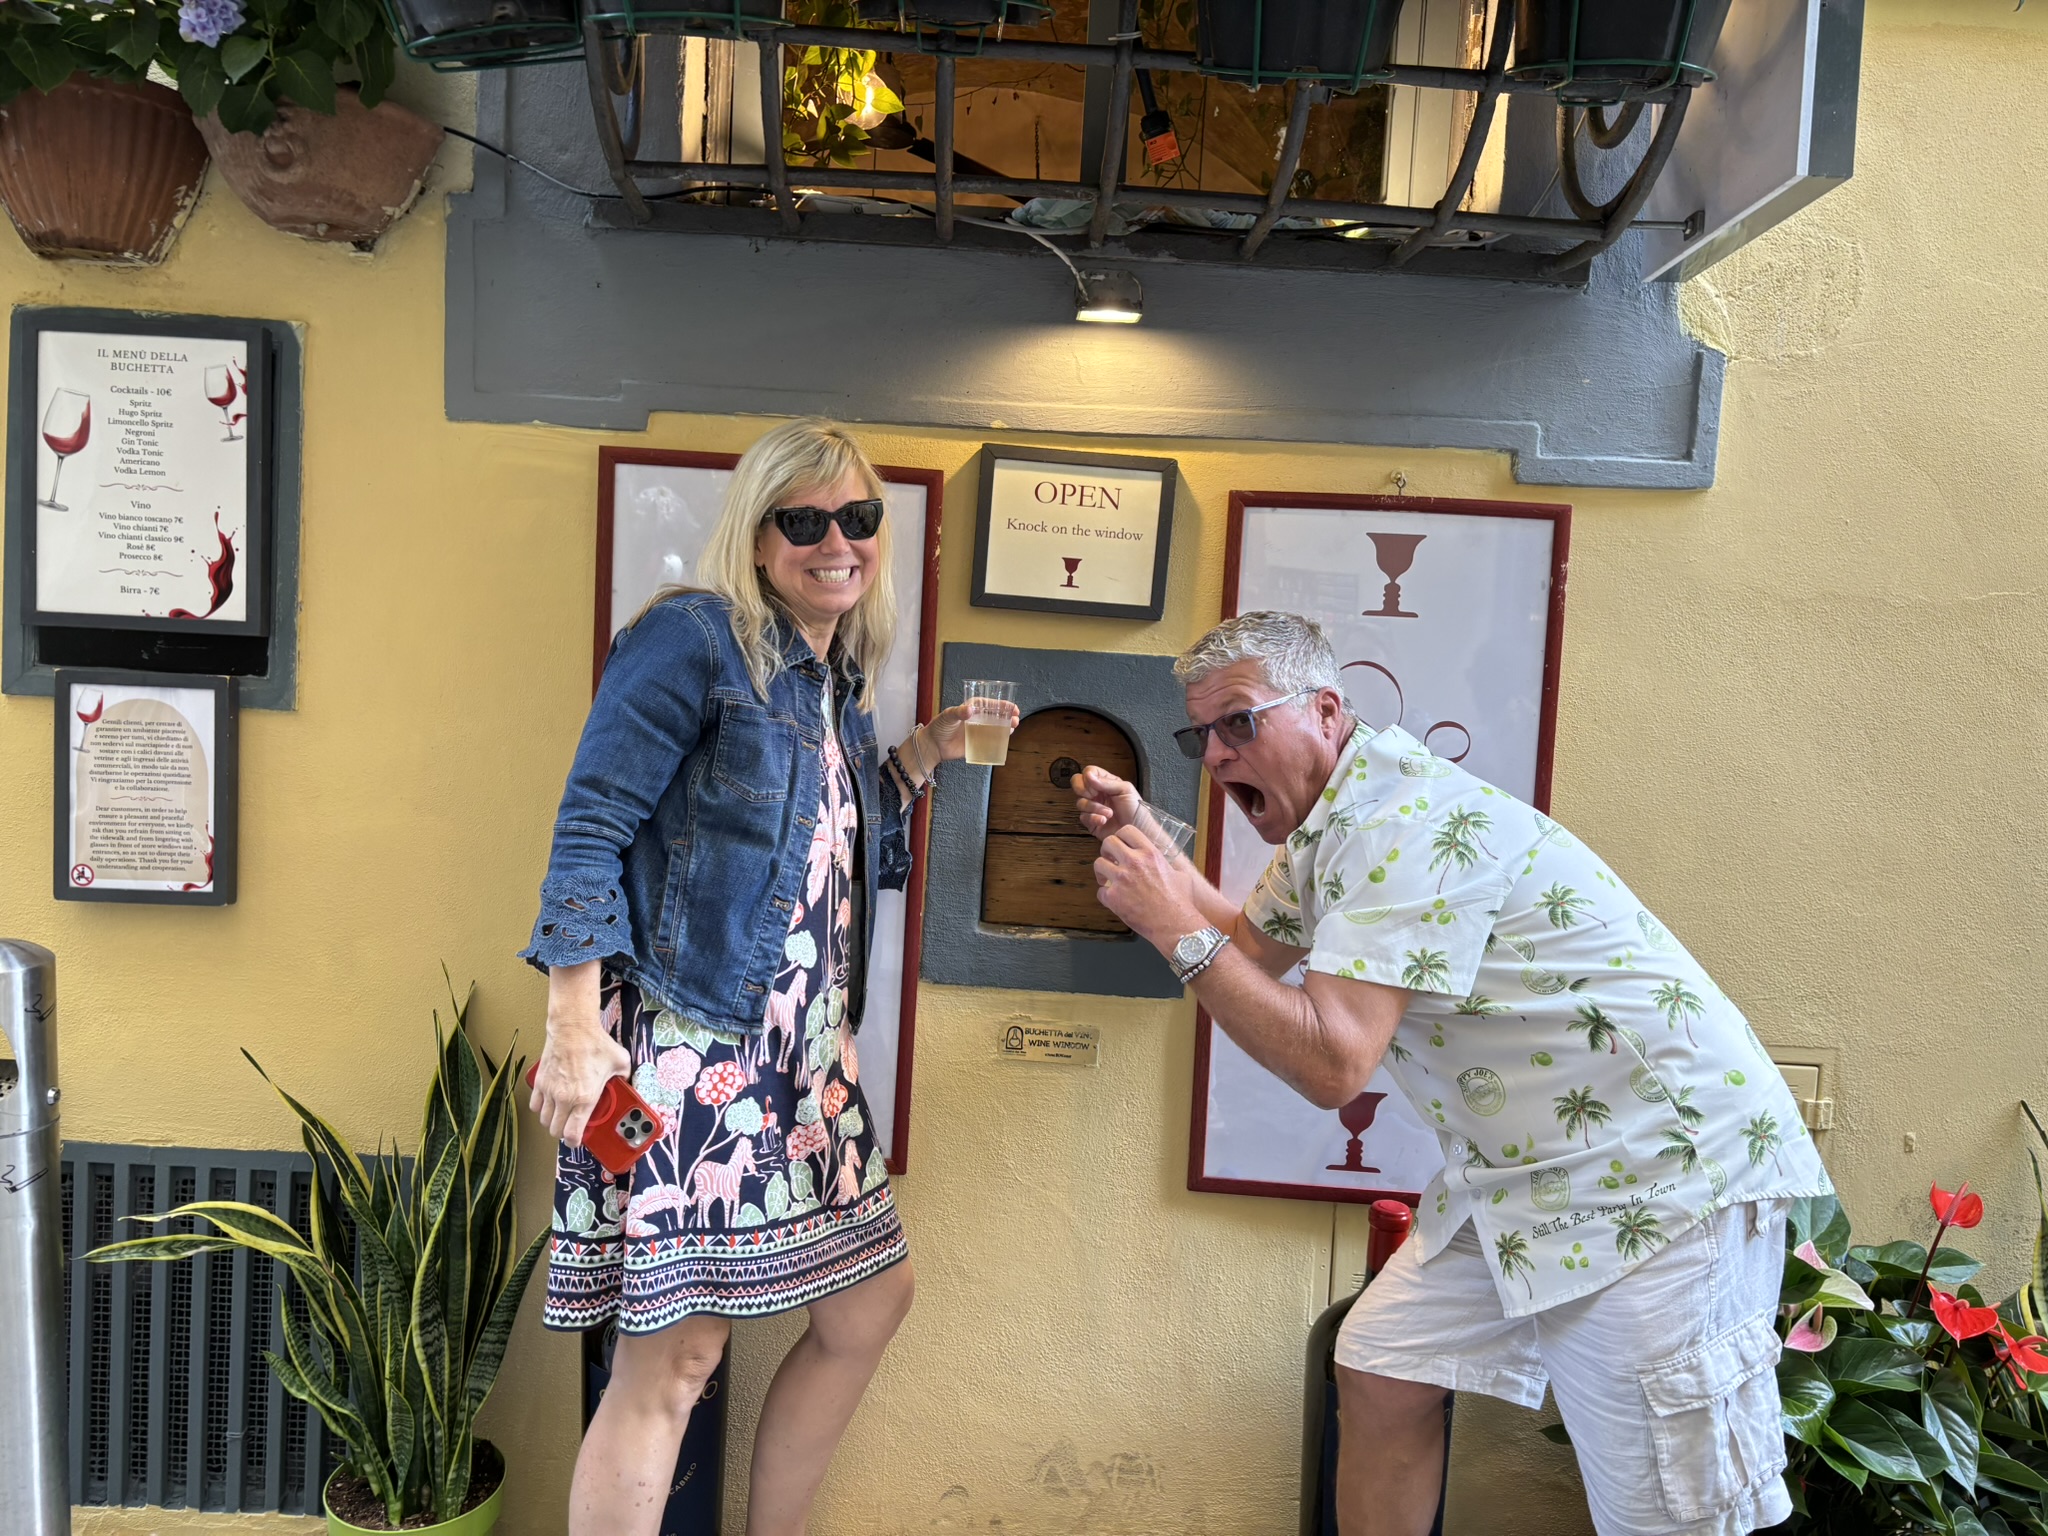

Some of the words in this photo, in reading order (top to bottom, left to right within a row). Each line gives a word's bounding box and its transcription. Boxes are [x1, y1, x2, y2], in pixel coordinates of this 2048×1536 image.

[98, 349, 108, 358] IL
[112, 350, 146, 360] MENÙ
[150, 352, 188, 362] DELLA
[110, 362, 174, 374] BUCHETTA
[110, 386, 148, 396] Cocktails
[156, 388, 172, 396] 10€
[130, 400, 152, 409] Spritz
[119, 409, 138, 418] Hugo
[140, 410, 162, 419] Spritz
[108, 418, 149, 427] Limoncello
[151, 420, 173, 429] Spritz
[125, 428, 155, 438] Negroni
[121, 438, 135, 446] Gin
[137, 439, 158, 447] Tonic
[117, 448, 139, 456] Vodka
[141, 449, 163, 457] Tonic
[120, 458, 160, 466] Americano
[114, 467, 137, 475] Vodka
[139, 468, 165, 476] Lemon
[1035, 481, 1122, 510] OPEN
[131, 501, 151, 509] Vino
[99, 512, 116, 520] Vino
[119, 513, 143, 521] bianco
[113, 523, 131, 531] Vino
[133, 524, 158, 532] chianti
[1007, 518, 1048, 533] Knock
[1052, 524, 1067, 534] on
[1072, 525, 1090, 536] the
[1095, 527, 1143, 541] window
[98, 532, 116, 540] Vino
[118, 533, 143, 541] chianti
[145, 534, 172, 542] classico
[119, 552, 151, 560] Prosecco
[120, 586, 141, 594] Birra
[1025, 1028, 1063, 1037] BUCHETTA
[1028, 1039, 1050, 1047] WINE
[1053, 1041, 1089, 1050] WINDOW
[1532, 1222, 1551, 1239] Still
[1551, 1217, 1569, 1232] The
[1570, 1210, 1596, 1227] Best
[1630, 1194, 1643, 1207] In
[1644, 1183, 1676, 1200] Town
[670, 1462, 697, 1494] CABREO
